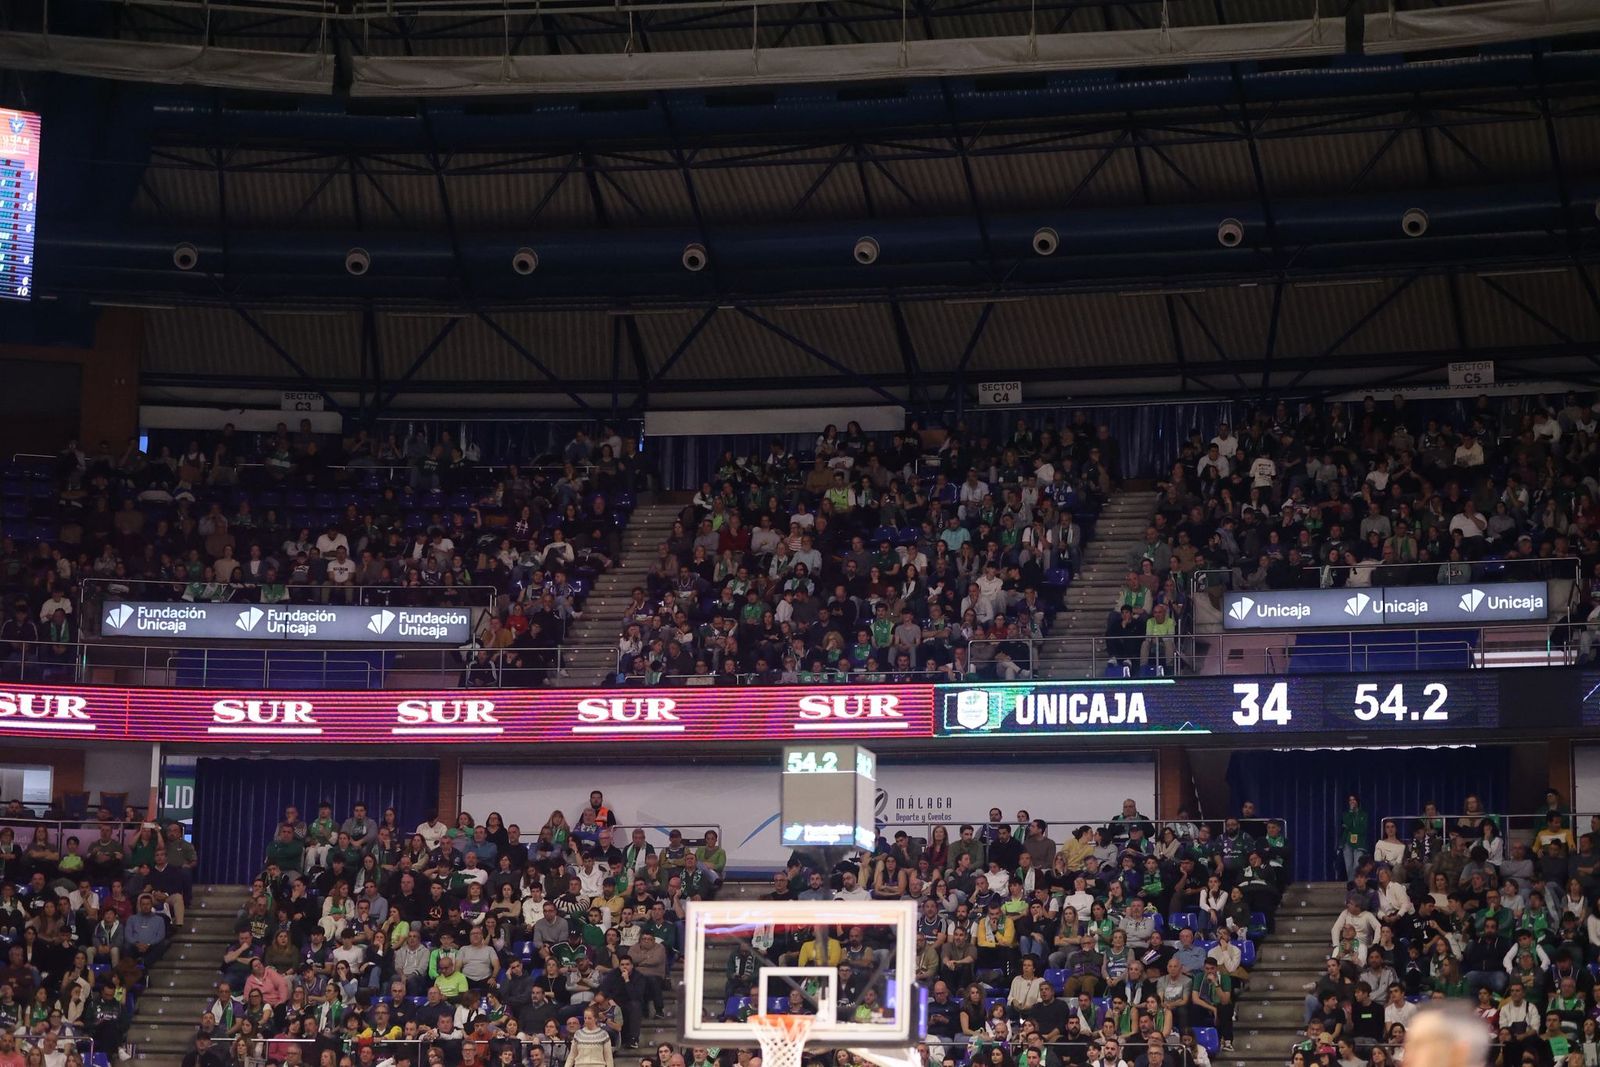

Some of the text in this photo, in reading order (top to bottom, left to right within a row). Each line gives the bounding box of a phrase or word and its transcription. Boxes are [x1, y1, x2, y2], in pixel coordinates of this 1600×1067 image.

[1451, 362, 1491, 372] SECTOR
[1464, 373, 1481, 383] C5
[981, 383, 1019, 391] SECTOR
[284, 392, 323, 400] SECTOR
[993, 393, 1009, 403] C4
[295, 401, 312, 411] C3
[1372, 598, 1428, 616] Unicaja
[1487, 594, 1544, 611] Unicaja
[137, 606, 207, 620] Fundación
[266, 609, 337, 622] Fundación
[398, 611, 468, 625] Fundación
[1256, 603, 1311, 620] Unicaja
[137, 618, 187, 634] Unicaja
[266, 621, 317, 637] Unicaja
[398, 623, 448, 639] Unicaja
[0, 692, 91, 718] SUR
[577, 698, 679, 722] SUR
[798, 694, 903, 719] SUR
[1014, 692, 1148, 725] UNICAJA
[1232, 682, 1292, 726] 34
[1354, 683, 1449, 721] 54.2
[212, 700, 316, 723] SUR
[396, 700, 497, 723] SUR
[787, 751, 838, 772] 54.2
[159, 785, 194, 809] LID
[896, 795, 952, 809] MÁLAGA
[896, 812, 952, 823] Deporte y Eventos
